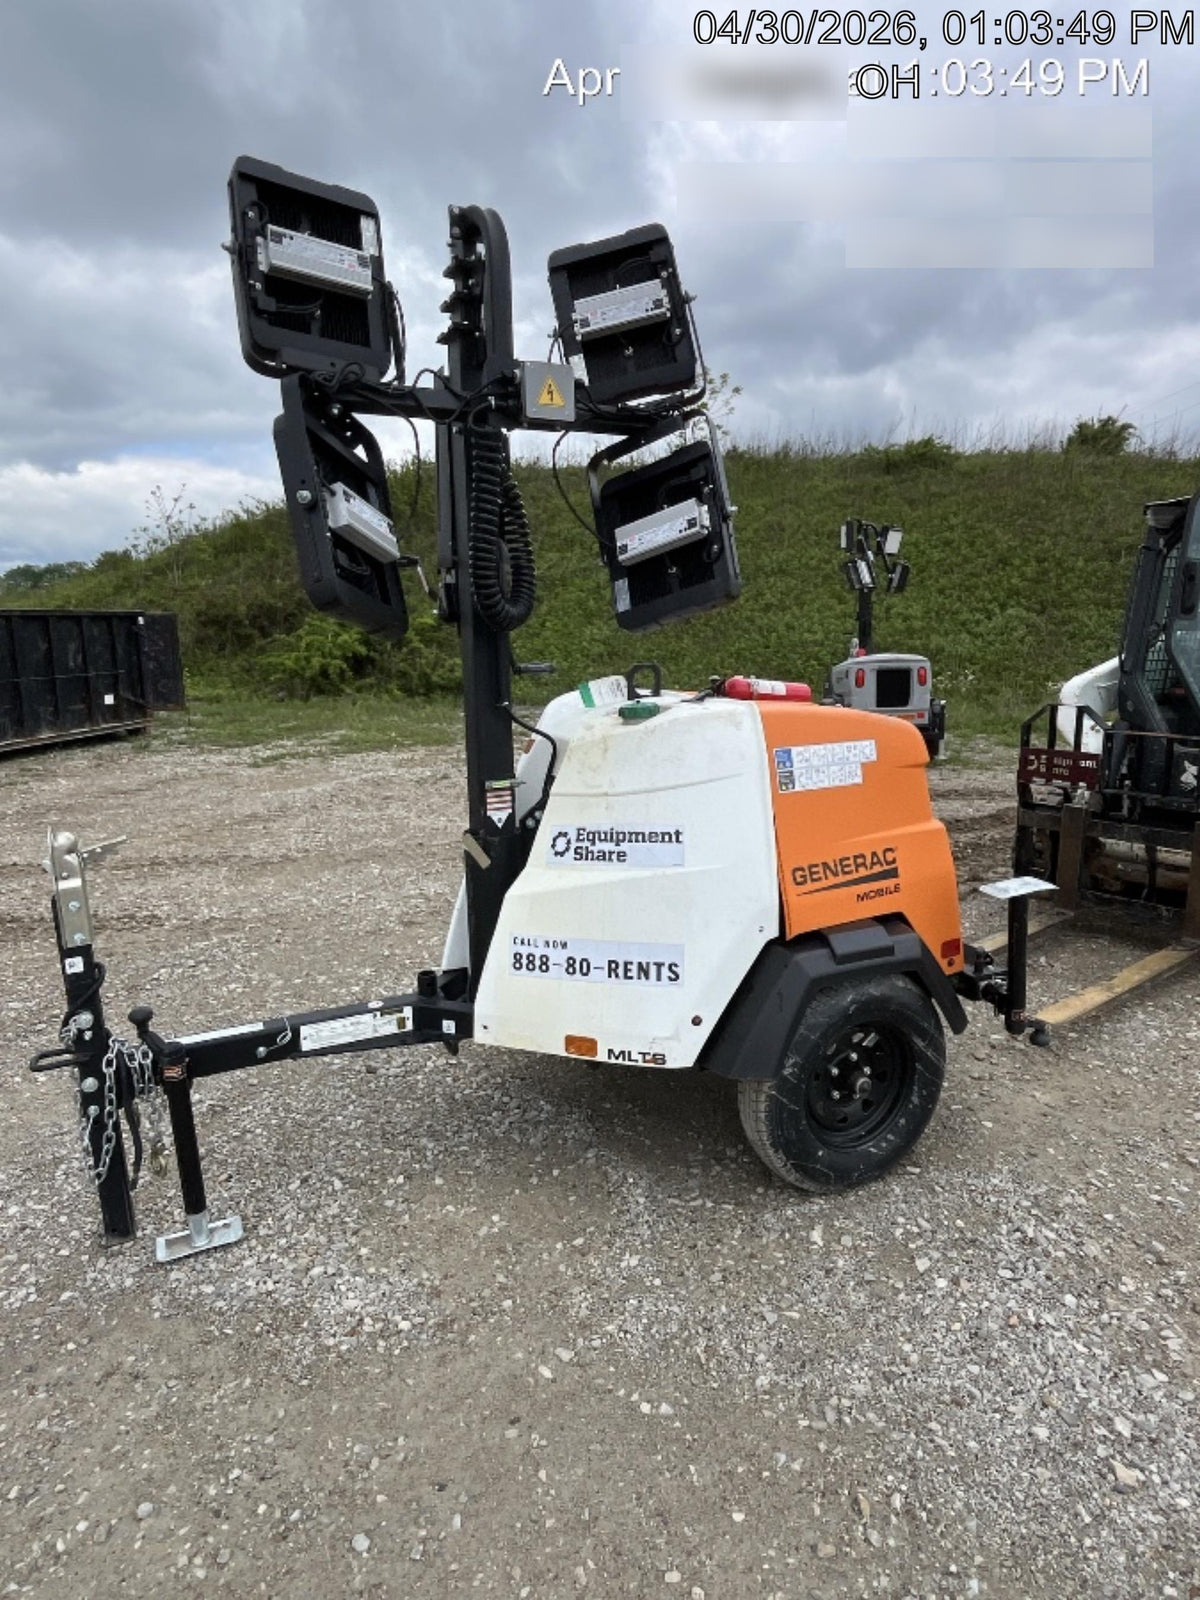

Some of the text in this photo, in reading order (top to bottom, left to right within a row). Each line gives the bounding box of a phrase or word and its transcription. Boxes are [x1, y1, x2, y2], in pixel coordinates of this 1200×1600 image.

[575, 827, 683, 846] Equipment
[573, 845, 628, 863] Share
[791, 847, 897, 886] GENERAC
[856, 883, 901, 902] MOBILE
[513, 936, 568, 950] CALL NOW
[512, 952, 680, 982] 888-80-RENTS
